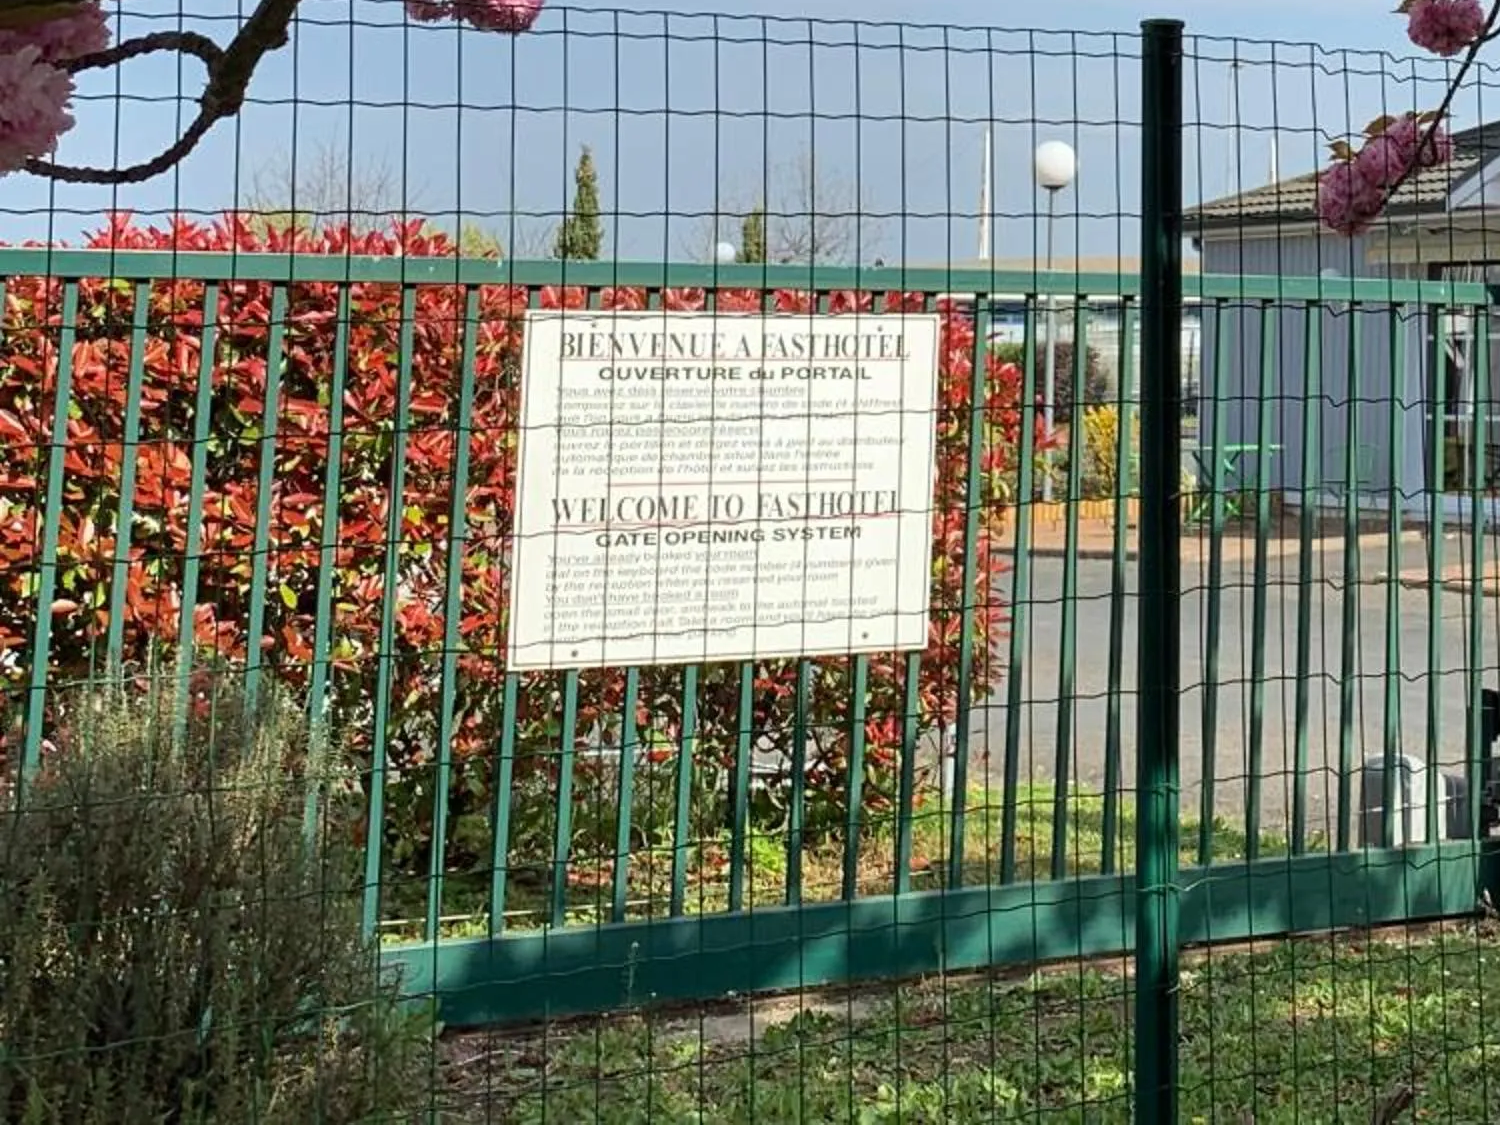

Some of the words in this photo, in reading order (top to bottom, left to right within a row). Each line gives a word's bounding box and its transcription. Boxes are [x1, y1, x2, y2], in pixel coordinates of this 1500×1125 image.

[560, 332, 727, 358] BIENVENUE
[736, 333, 751, 358] A
[760, 333, 911, 358] FASTHOTEL
[599, 366, 742, 380] OUVERTURE
[748, 366, 775, 380] du
[781, 365, 873, 380] PORTAIL
[552, 494, 699, 523] WELCOME
[711, 493, 745, 520] TO
[758, 489, 902, 519] FASTHOTEL
[595, 532, 657, 548] GATE
[664, 529, 766, 546] OPENING
[772, 525, 862, 543] SYSTEM
